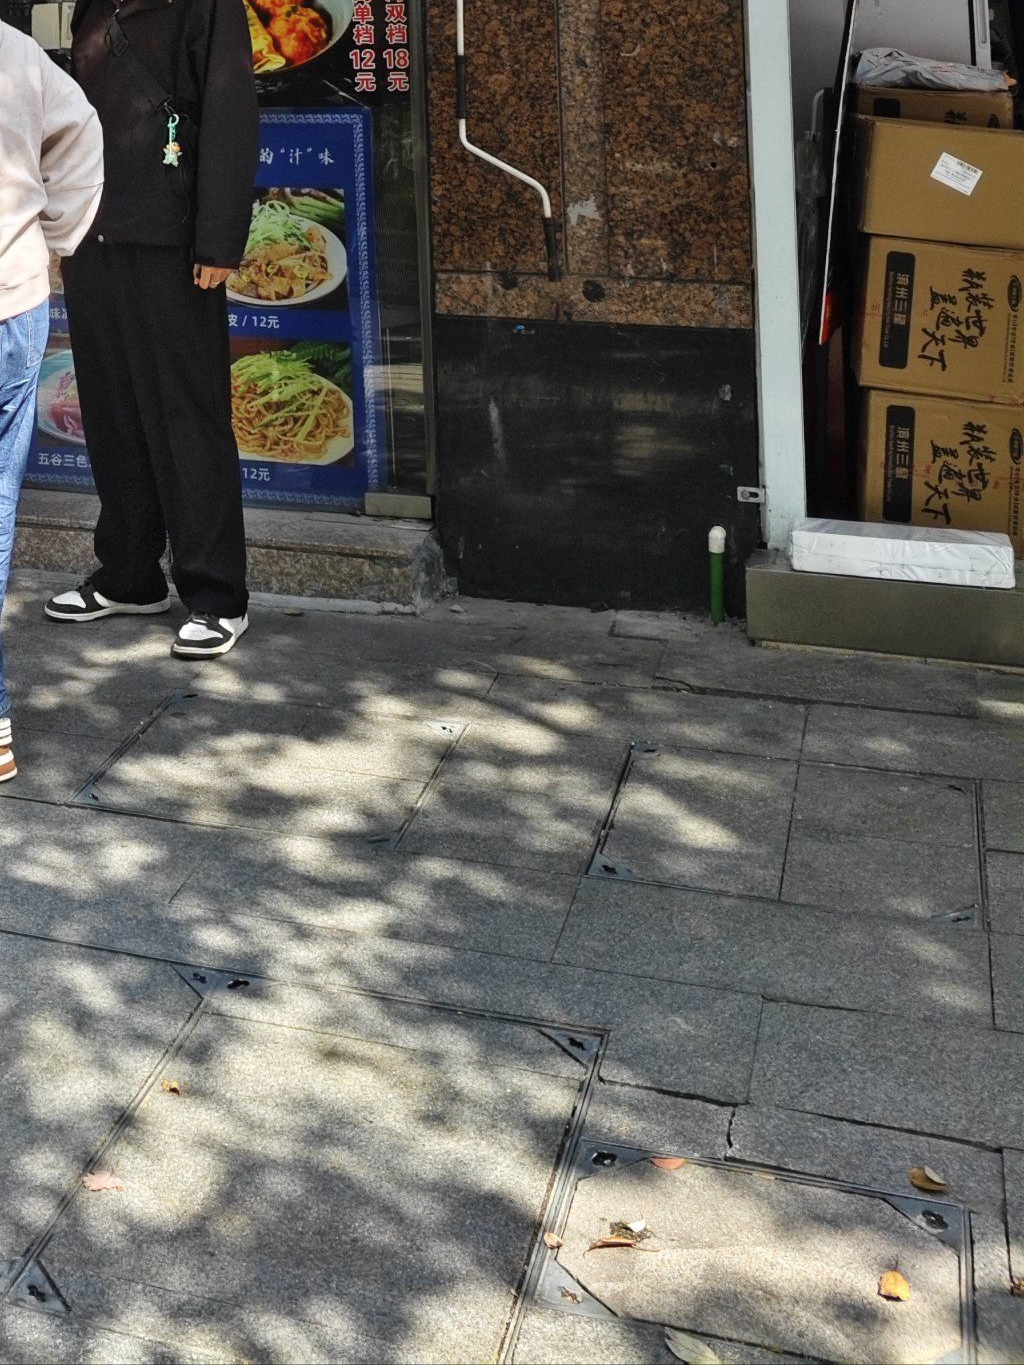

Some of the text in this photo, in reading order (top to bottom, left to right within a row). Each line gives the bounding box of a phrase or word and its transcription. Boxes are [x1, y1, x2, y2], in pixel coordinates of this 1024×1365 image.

[38, 452, 89, 468] 五谷三色
[241, 467, 271, 482] 12元
